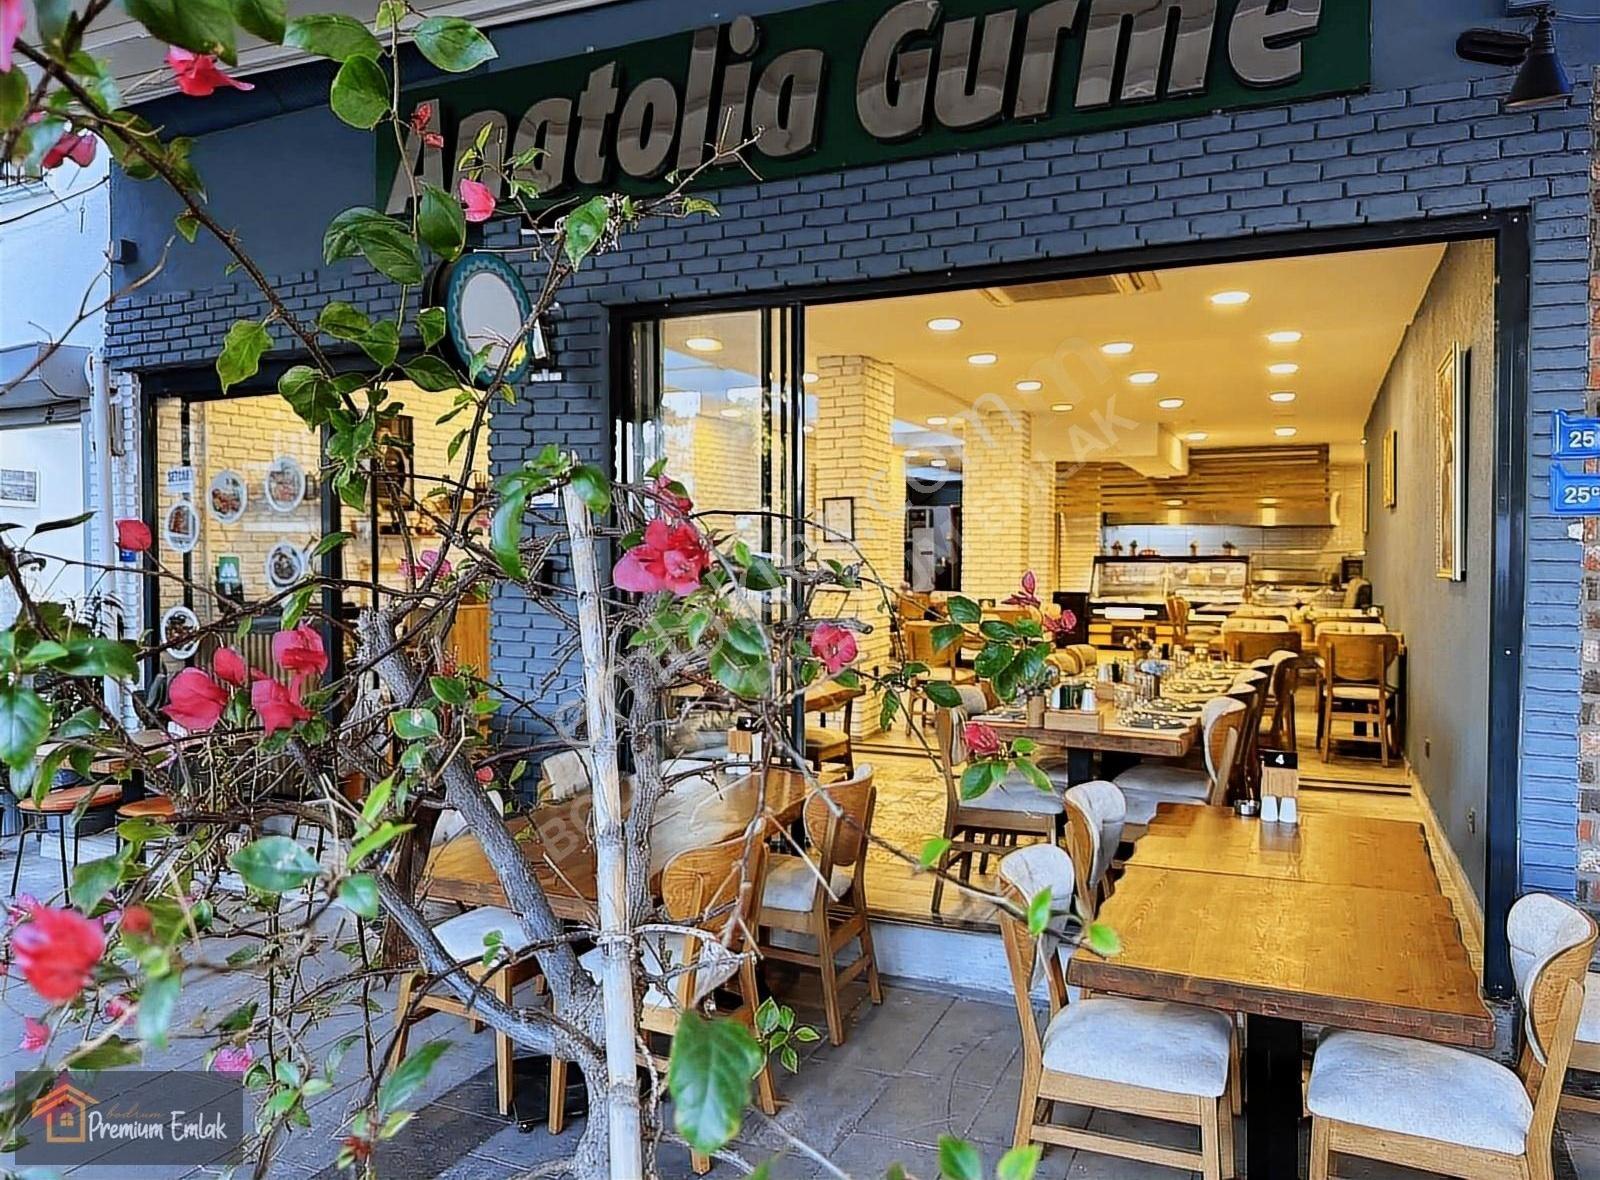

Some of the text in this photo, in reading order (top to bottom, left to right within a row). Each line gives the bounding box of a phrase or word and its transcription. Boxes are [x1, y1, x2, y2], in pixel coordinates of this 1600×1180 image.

[385, 0, 1321, 215] Anatolia Gurme
[1569, 430, 1595, 448] 25
